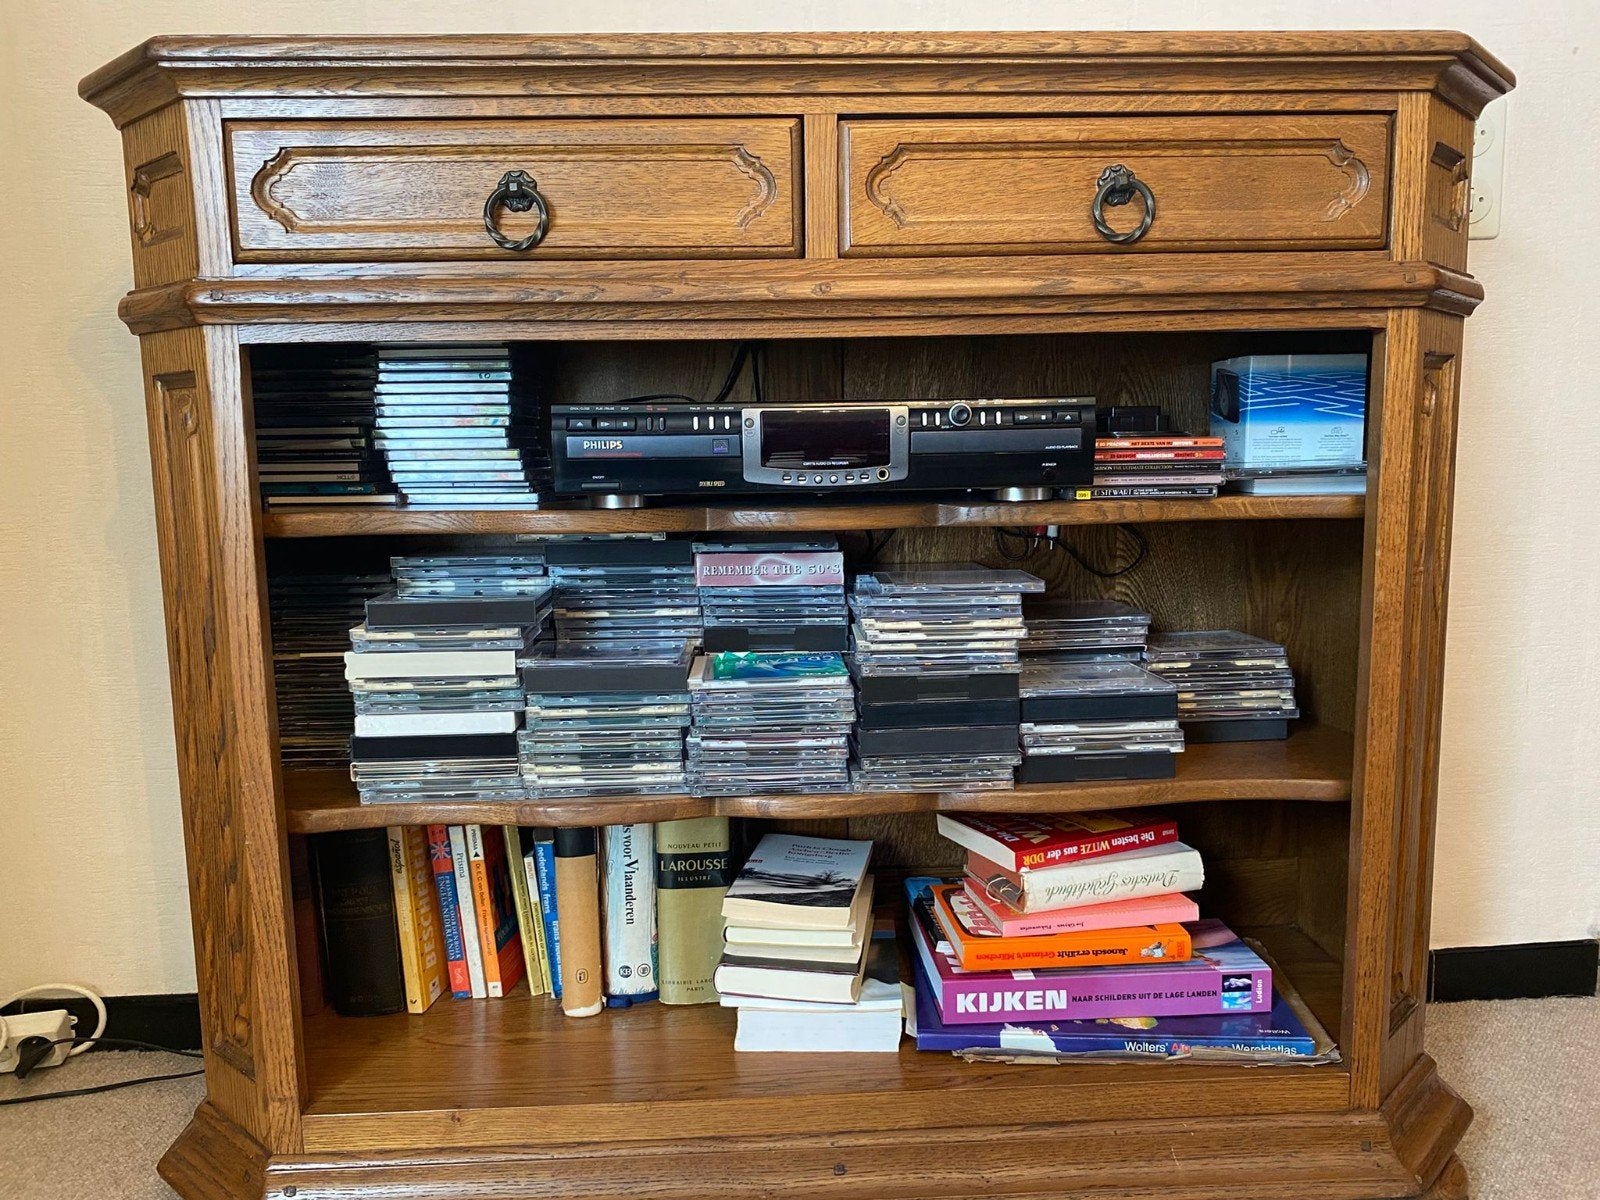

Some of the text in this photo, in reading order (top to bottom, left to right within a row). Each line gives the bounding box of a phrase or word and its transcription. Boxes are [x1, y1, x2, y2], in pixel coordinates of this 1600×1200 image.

[583, 440, 623, 450] PHILIPS
[703, 563, 841, 576] REMEMBER THE 50'S
[1111, 834, 1138, 846] besten
[1141, 831, 1155, 842] Die
[623, 834, 633, 860] voor
[1047, 849, 1061, 859] der
[1064, 846, 1078, 856] aus
[1080, 840, 1110, 855] WITZE
[390, 838, 405, 874] español
[1023, 854, 1045, 866] DDR
[456, 852, 466, 878] Prisma
[660, 858, 729, 871] LAROUSSE
[537, 846, 551, 914] nederlands frans
[1045, 870, 1179, 902] Deutsches Gedichtbuch
[624, 859, 639, 925] Vlaanderen
[976, 948, 1128, 962] Janosch erzählt Grimm's Märchen
[1255, 979, 1263, 1003] Ludion
[956, 989, 1067, 1013] KIJKEN
[1095, 993, 1137, 1001] SCHILDERS
[1165, 991, 1185, 999] LAGE
[1187, 990, 1217, 998] LANDEN
[1124, 1041, 1168, 1053] Wolters'
